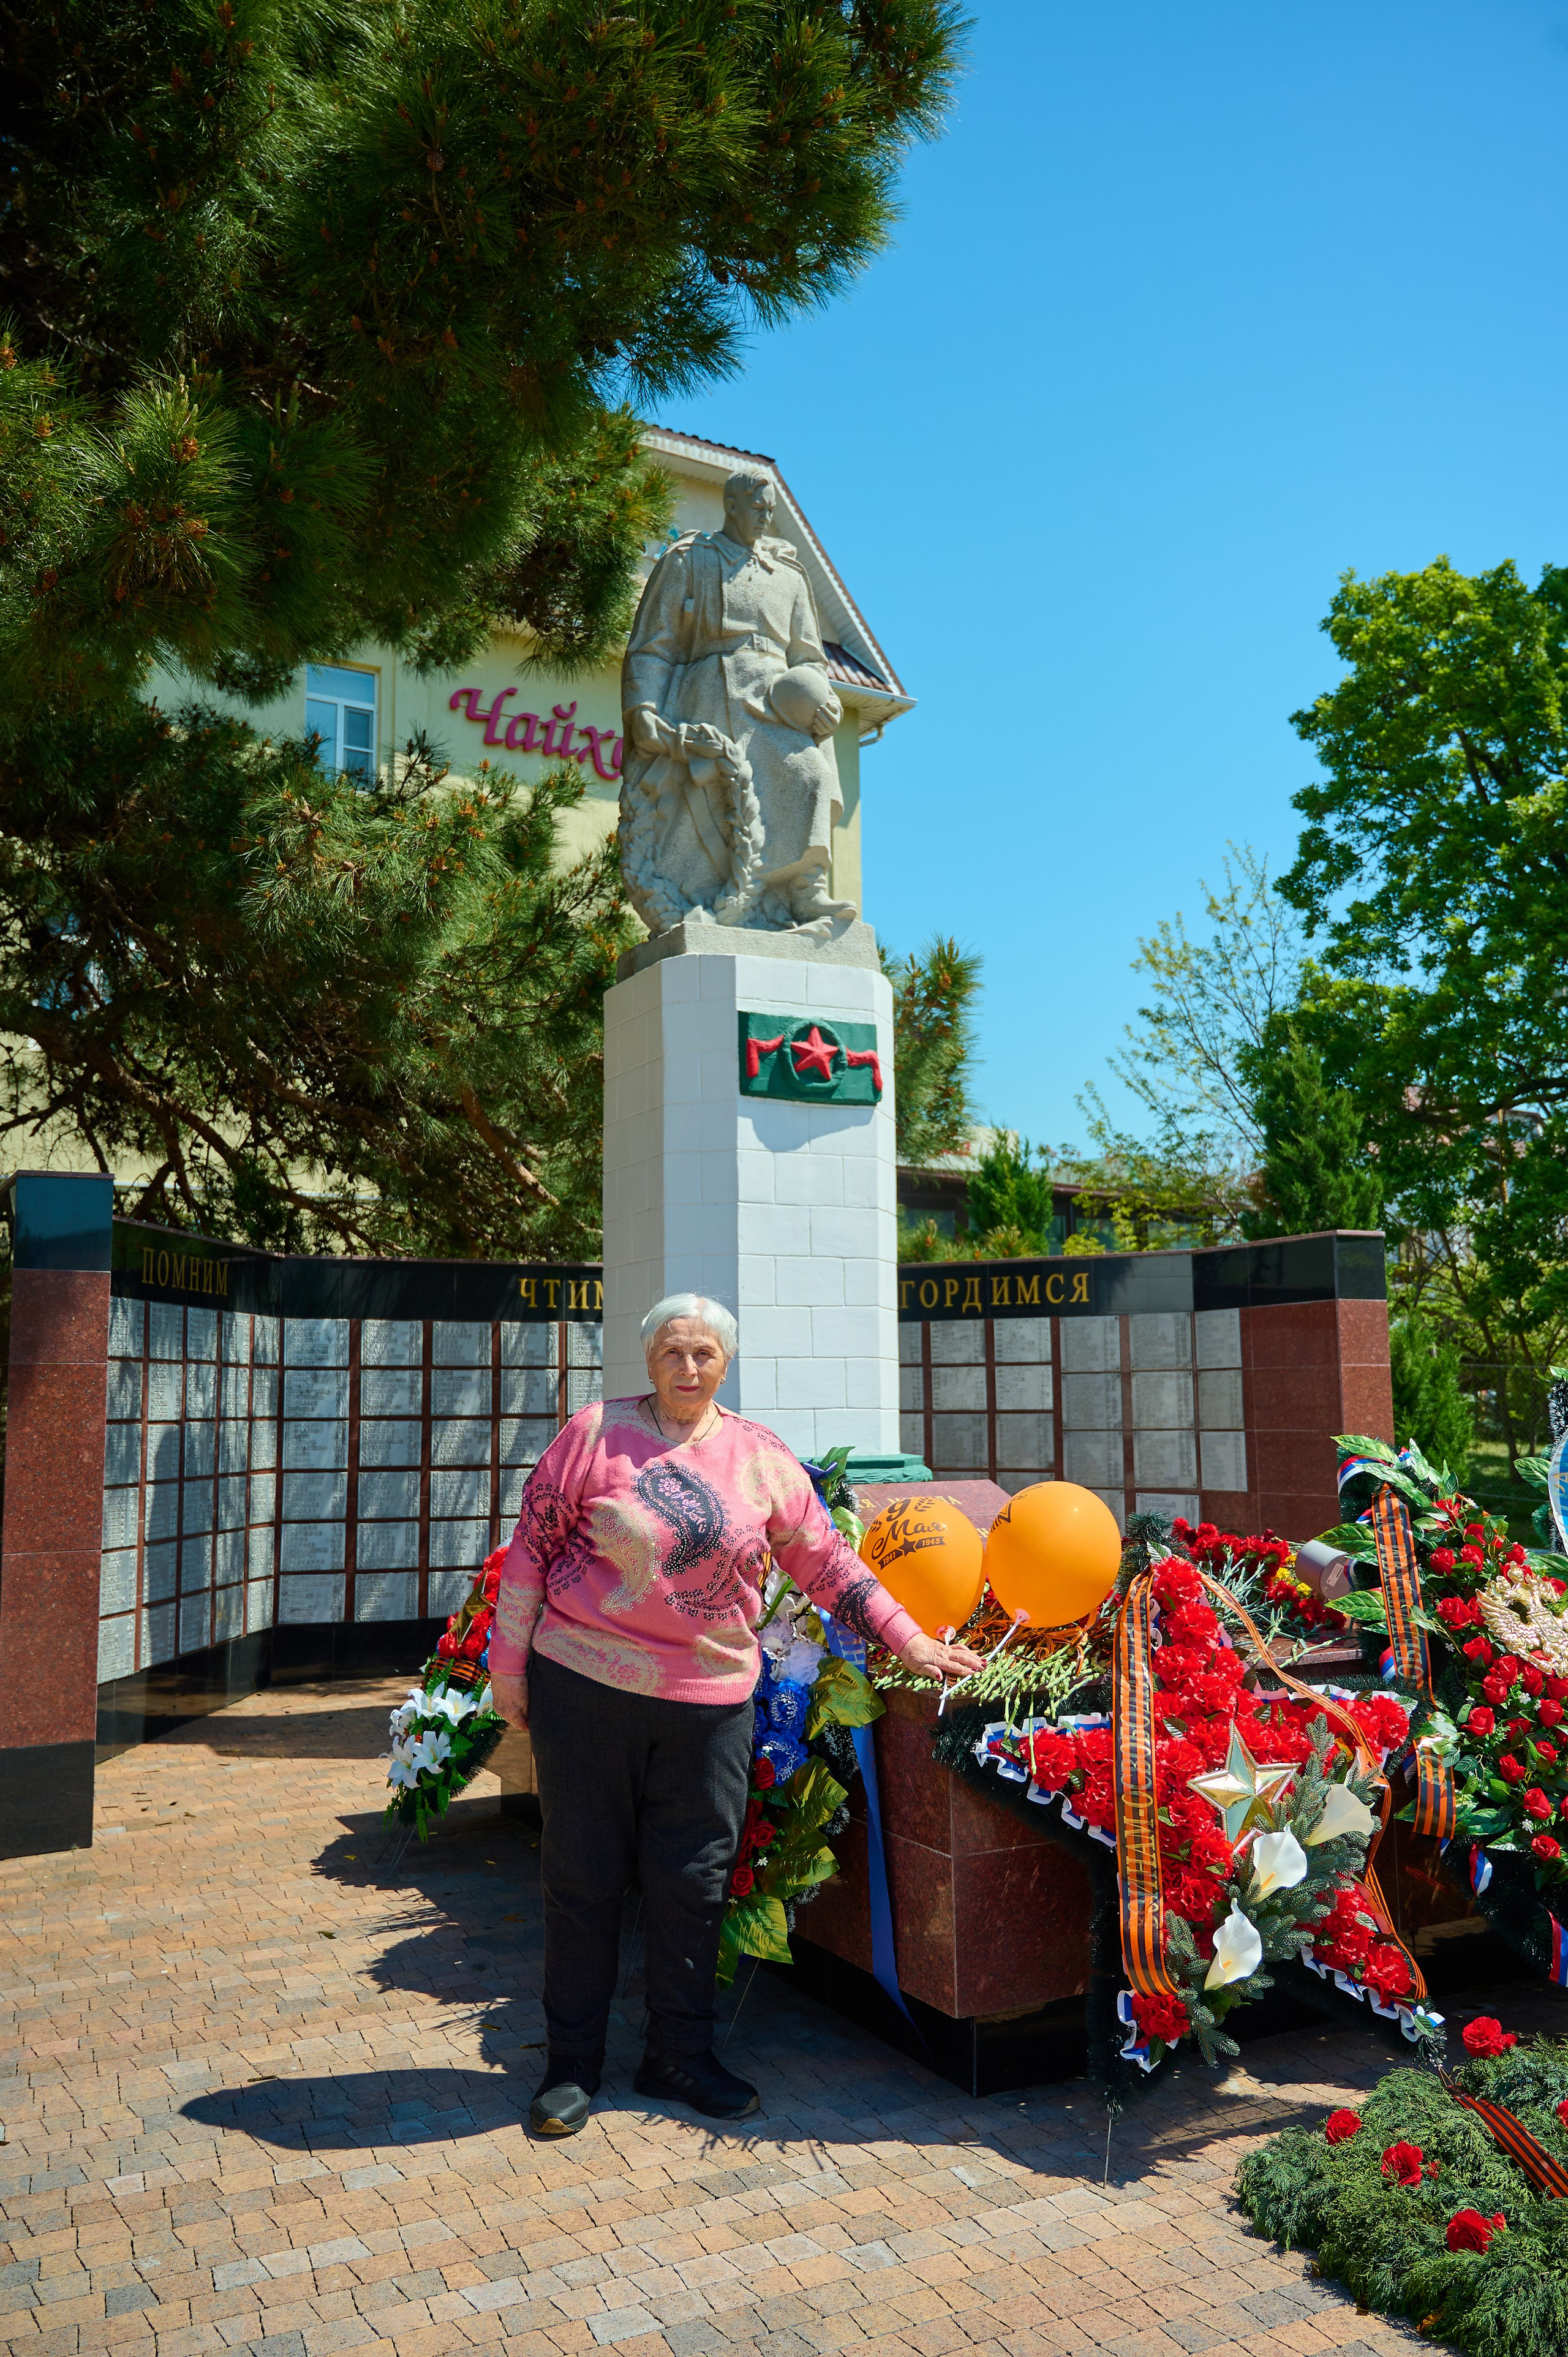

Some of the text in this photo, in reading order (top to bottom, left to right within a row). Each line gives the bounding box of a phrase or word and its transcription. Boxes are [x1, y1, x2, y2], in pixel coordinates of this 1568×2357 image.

[141, 1247, 228, 1295] ПОМНИМ
[900, 1273, 1090, 1313] ГОРДИМСЯ
[886, 1498, 911, 1522] 9
[872, 1519, 948, 1560] Мая
[883, 1537, 941, 1566] 1941 1945
[1381, 1543, 1425, 1680] ОБЕДИТЕЛЯМ
